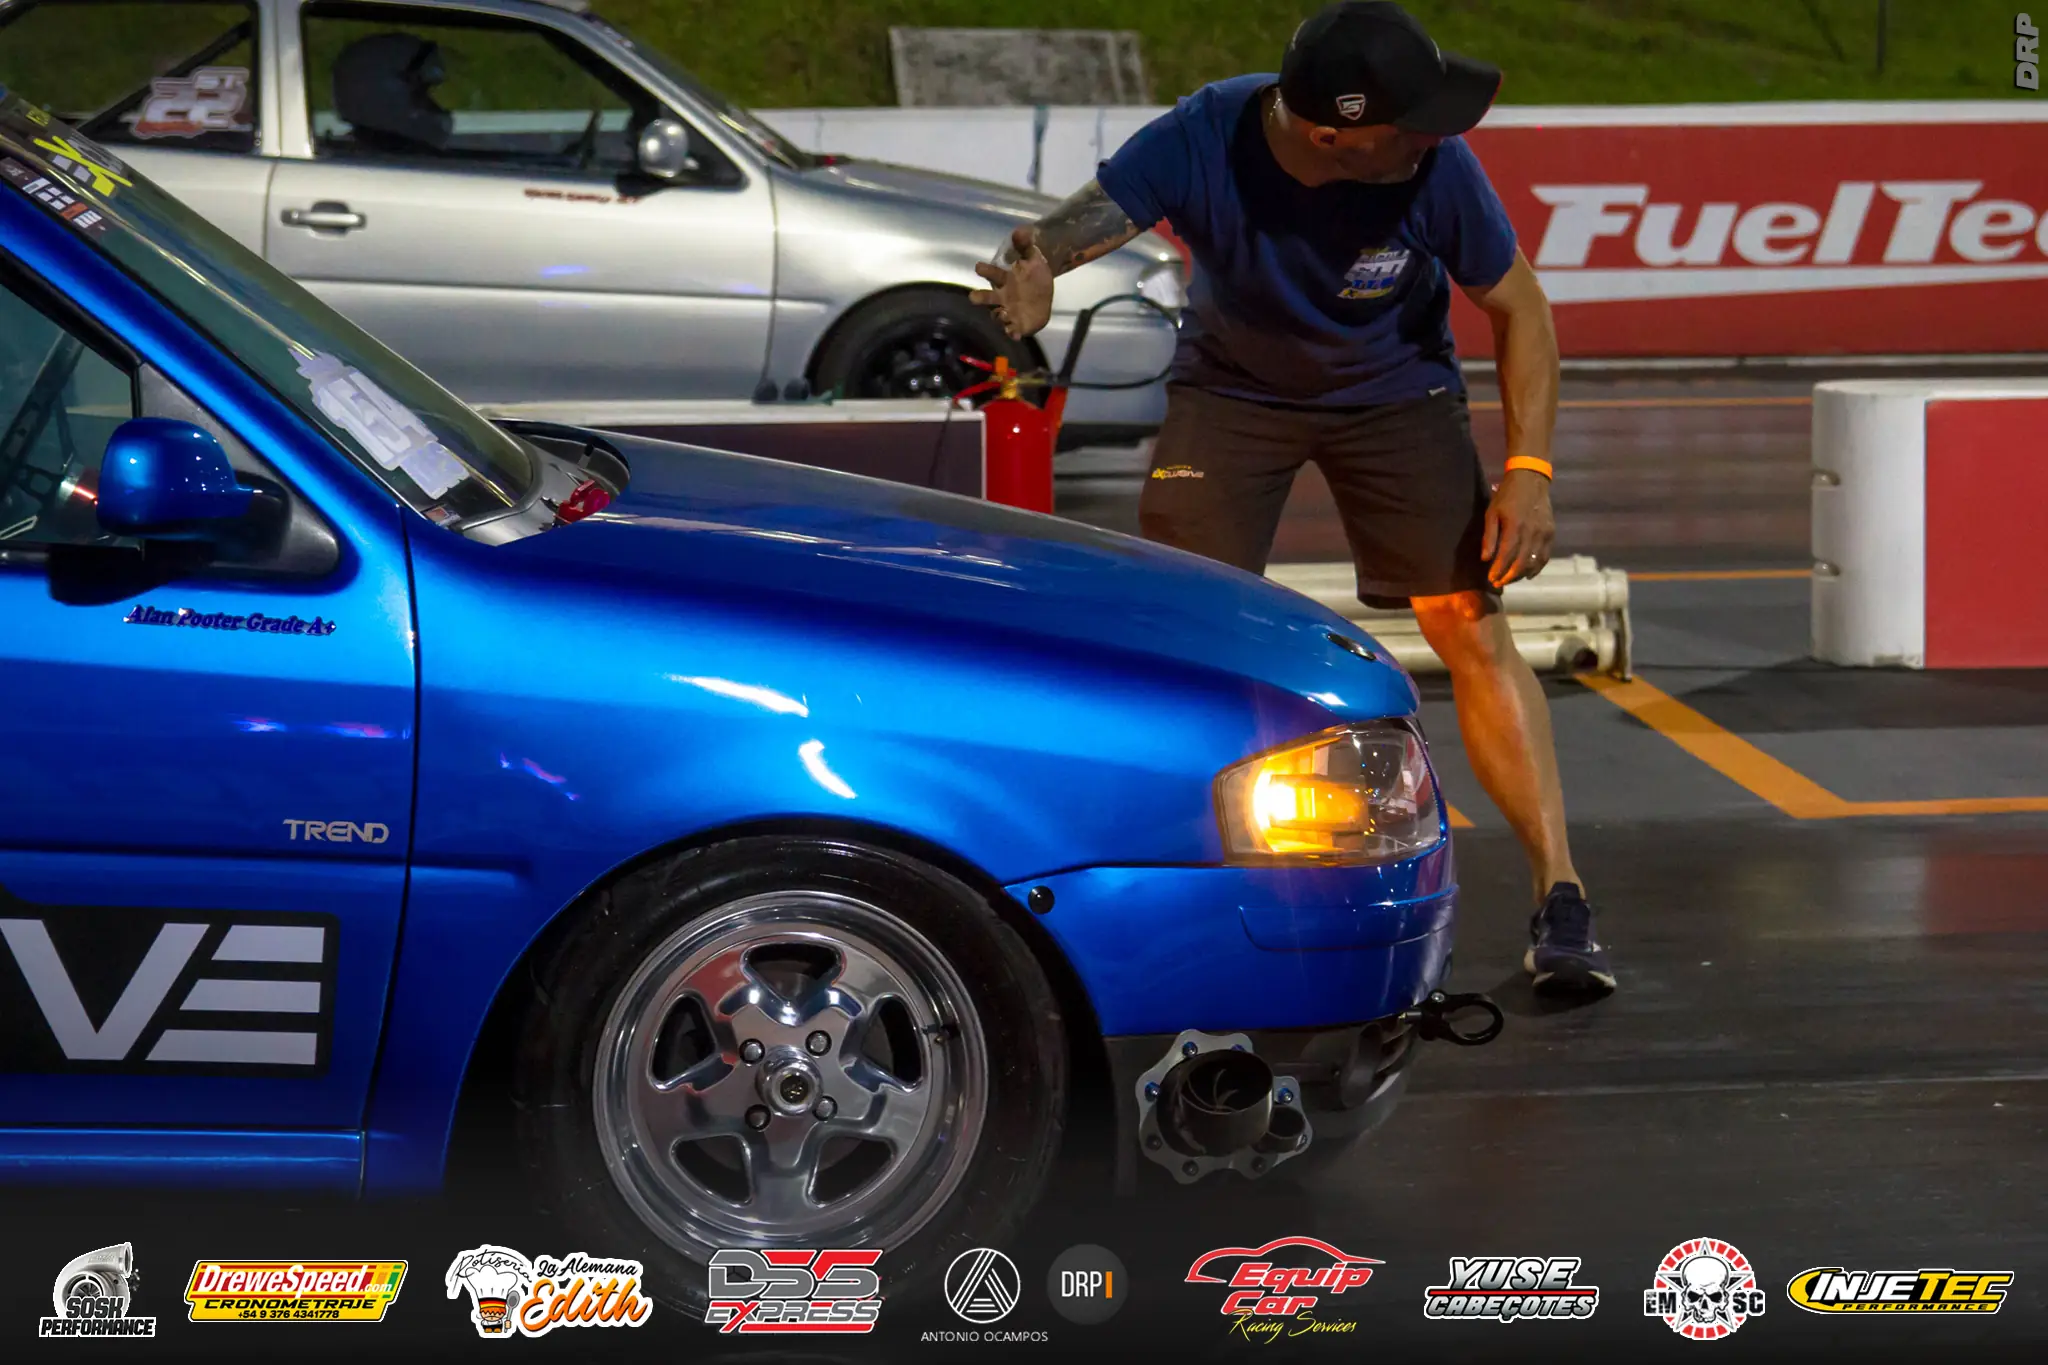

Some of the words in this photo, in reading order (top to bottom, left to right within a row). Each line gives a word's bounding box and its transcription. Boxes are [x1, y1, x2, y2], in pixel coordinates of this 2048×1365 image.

[1530, 180, 2048, 267] FuelTe
[123, 604, 173, 625] Alan
[177, 607, 246, 628] Pooter
[245, 612, 304, 634] Grade
[306, 615, 337, 636] A+
[283, 819, 389, 844] TREND
